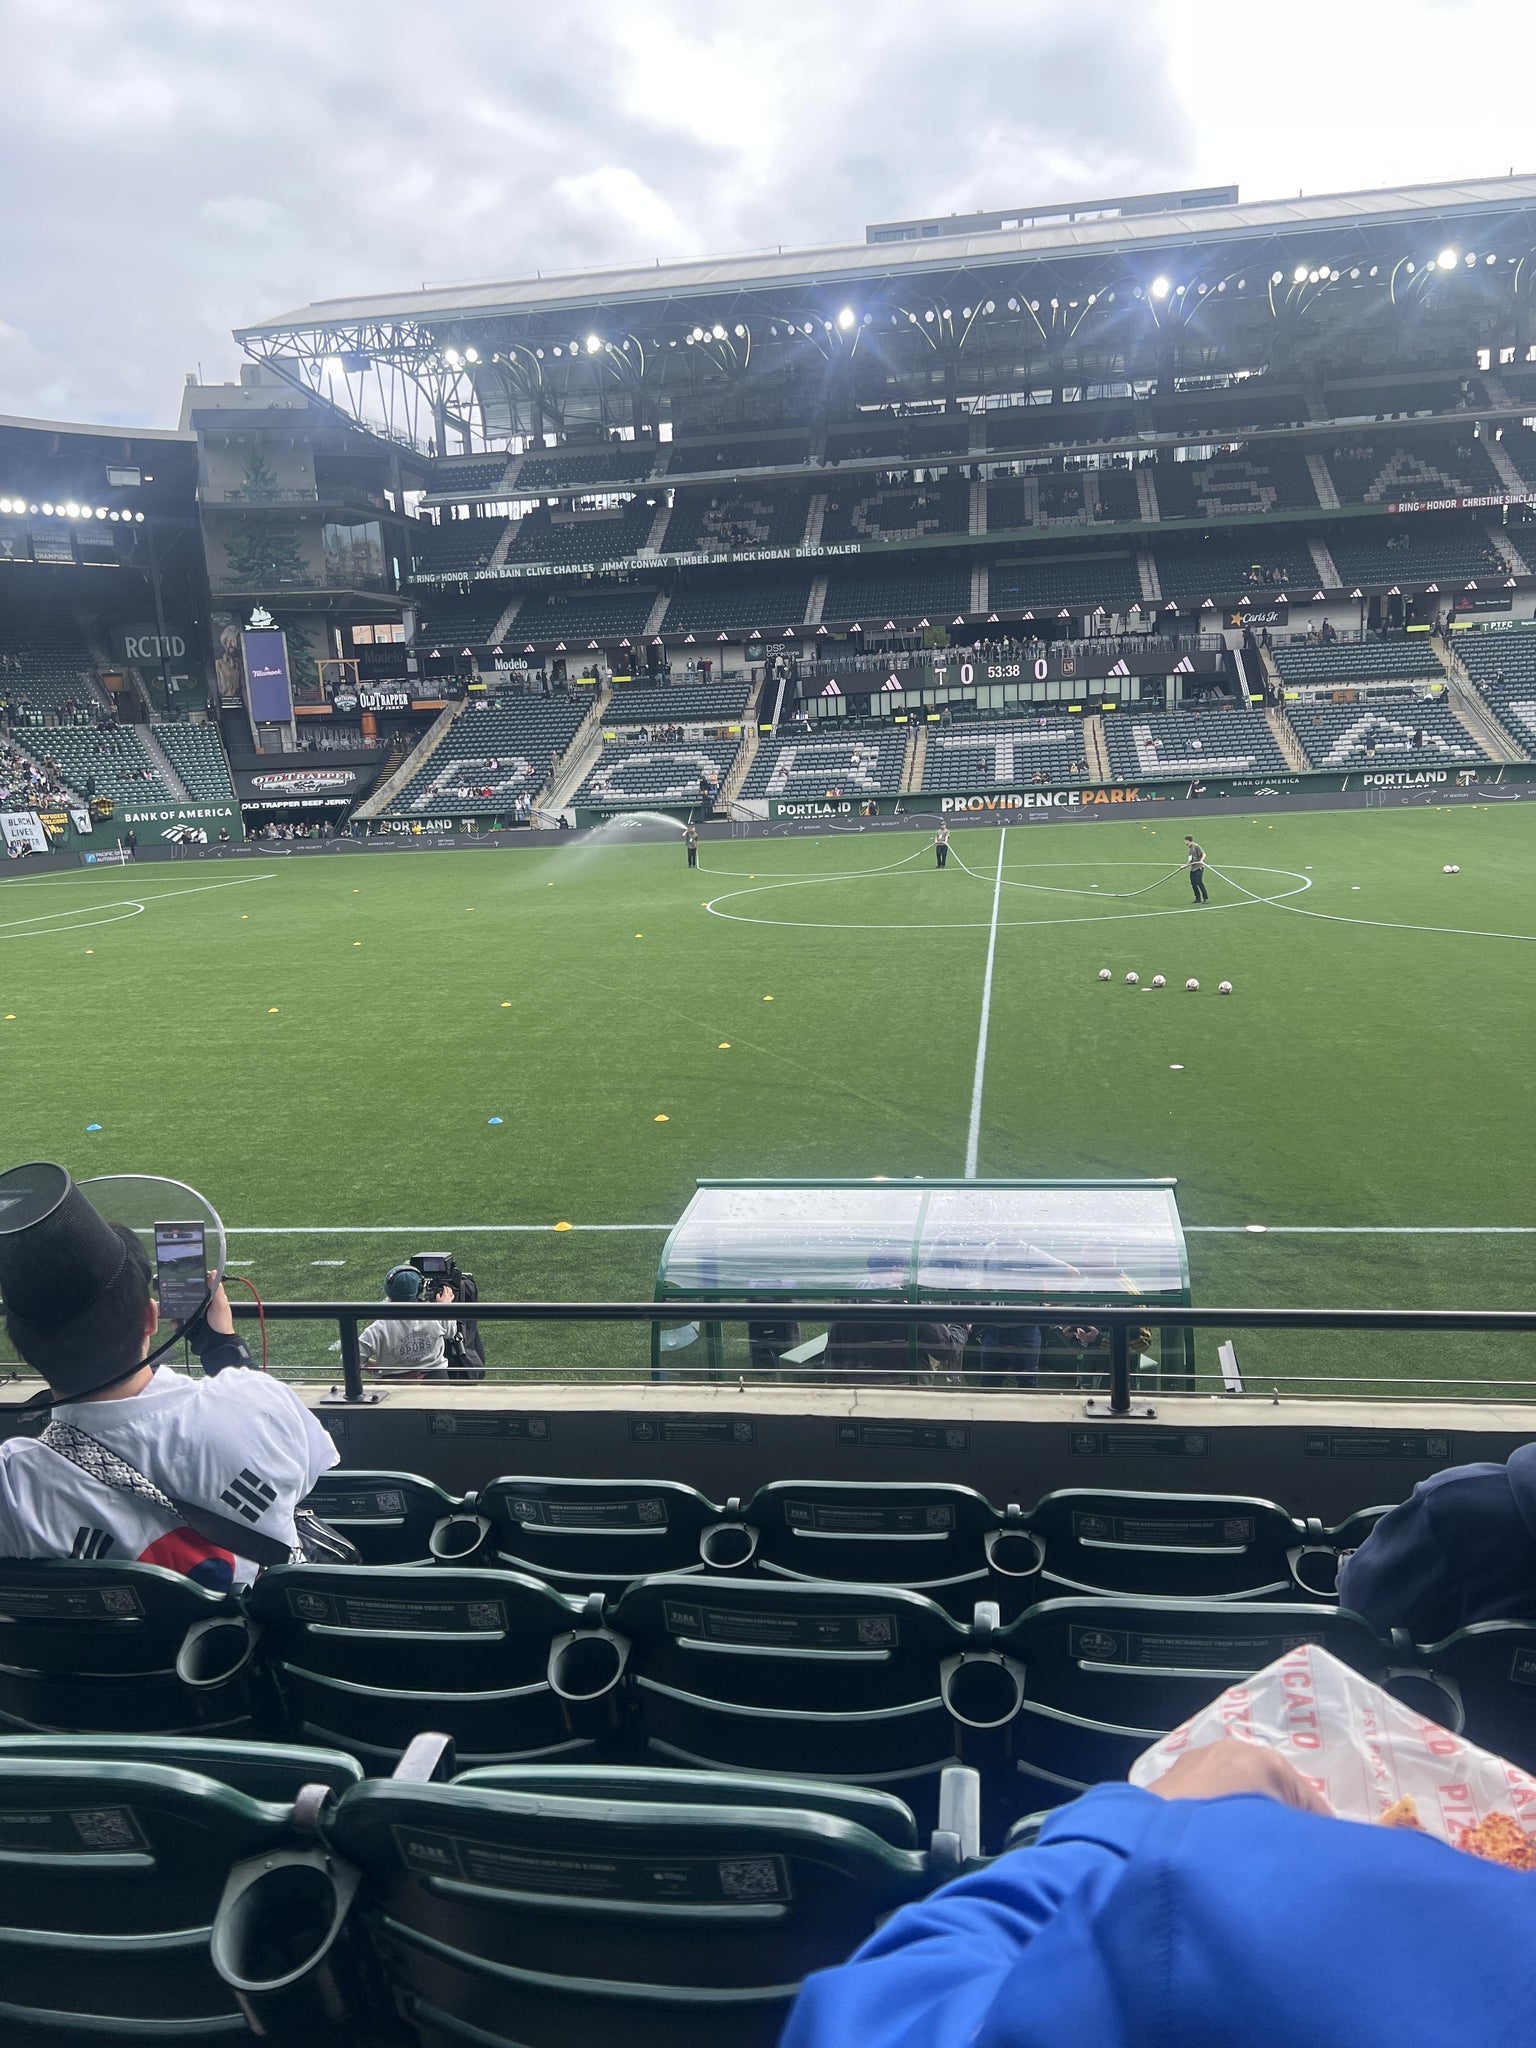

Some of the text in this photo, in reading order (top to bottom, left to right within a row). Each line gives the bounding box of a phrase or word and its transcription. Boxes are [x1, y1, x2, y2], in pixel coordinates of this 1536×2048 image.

[1399, 502, 1420, 512] RING
[1427, 500, 1457, 510] HONOR
[1462, 495, 1504, 507] CHRISTINE
[416, 573, 435, 583] RING
[441, 572, 469, 582] HONOR
[474, 570, 498, 580] JOHN
[500, 568, 521, 578] BAIN
[526, 566, 551, 577] CLIVE
[553, 563, 594, 575] CHARLES
[601, 561, 629, 571] JIMMY
[631, 558, 668, 569] CONWAY
[675, 555, 709, 566] TIMBER
[711, 554, 727, 563] JIM
[733, 552, 757, 562] MICK
[757, 549, 790, 560] HOBAN
[795, 547, 824, 558] DIEGO
[826, 544, 860, 555] VALERI
[1490, 621, 1513, 629] PTFC
[765, 643, 785, 652] DSP
[494, 657, 528, 671] Modelo
[960, 663, 974, 685] 0
[987, 664, 1021, 678] 53:38
[1034, 658, 1048, 680] 0
[252, 771, 356, 786] OLD TRAPPER
[1363, 770, 1448, 785] PORTLAND
[261, 801, 300, 809] TRAPPER
[941, 788, 1141, 812] PROVIDENCE PARK
[8, 817, 31, 826] BLACK
[124, 808, 233, 822] BANK OF AMERICA
[384, 819, 453, 831] ORLAND
[11, 828, 33, 837] LIVES
[12, 839, 40, 847] ATER
[400, 1341, 431, 1355] SPURS
[1438, 1782, 1478, 1847] PIZ
